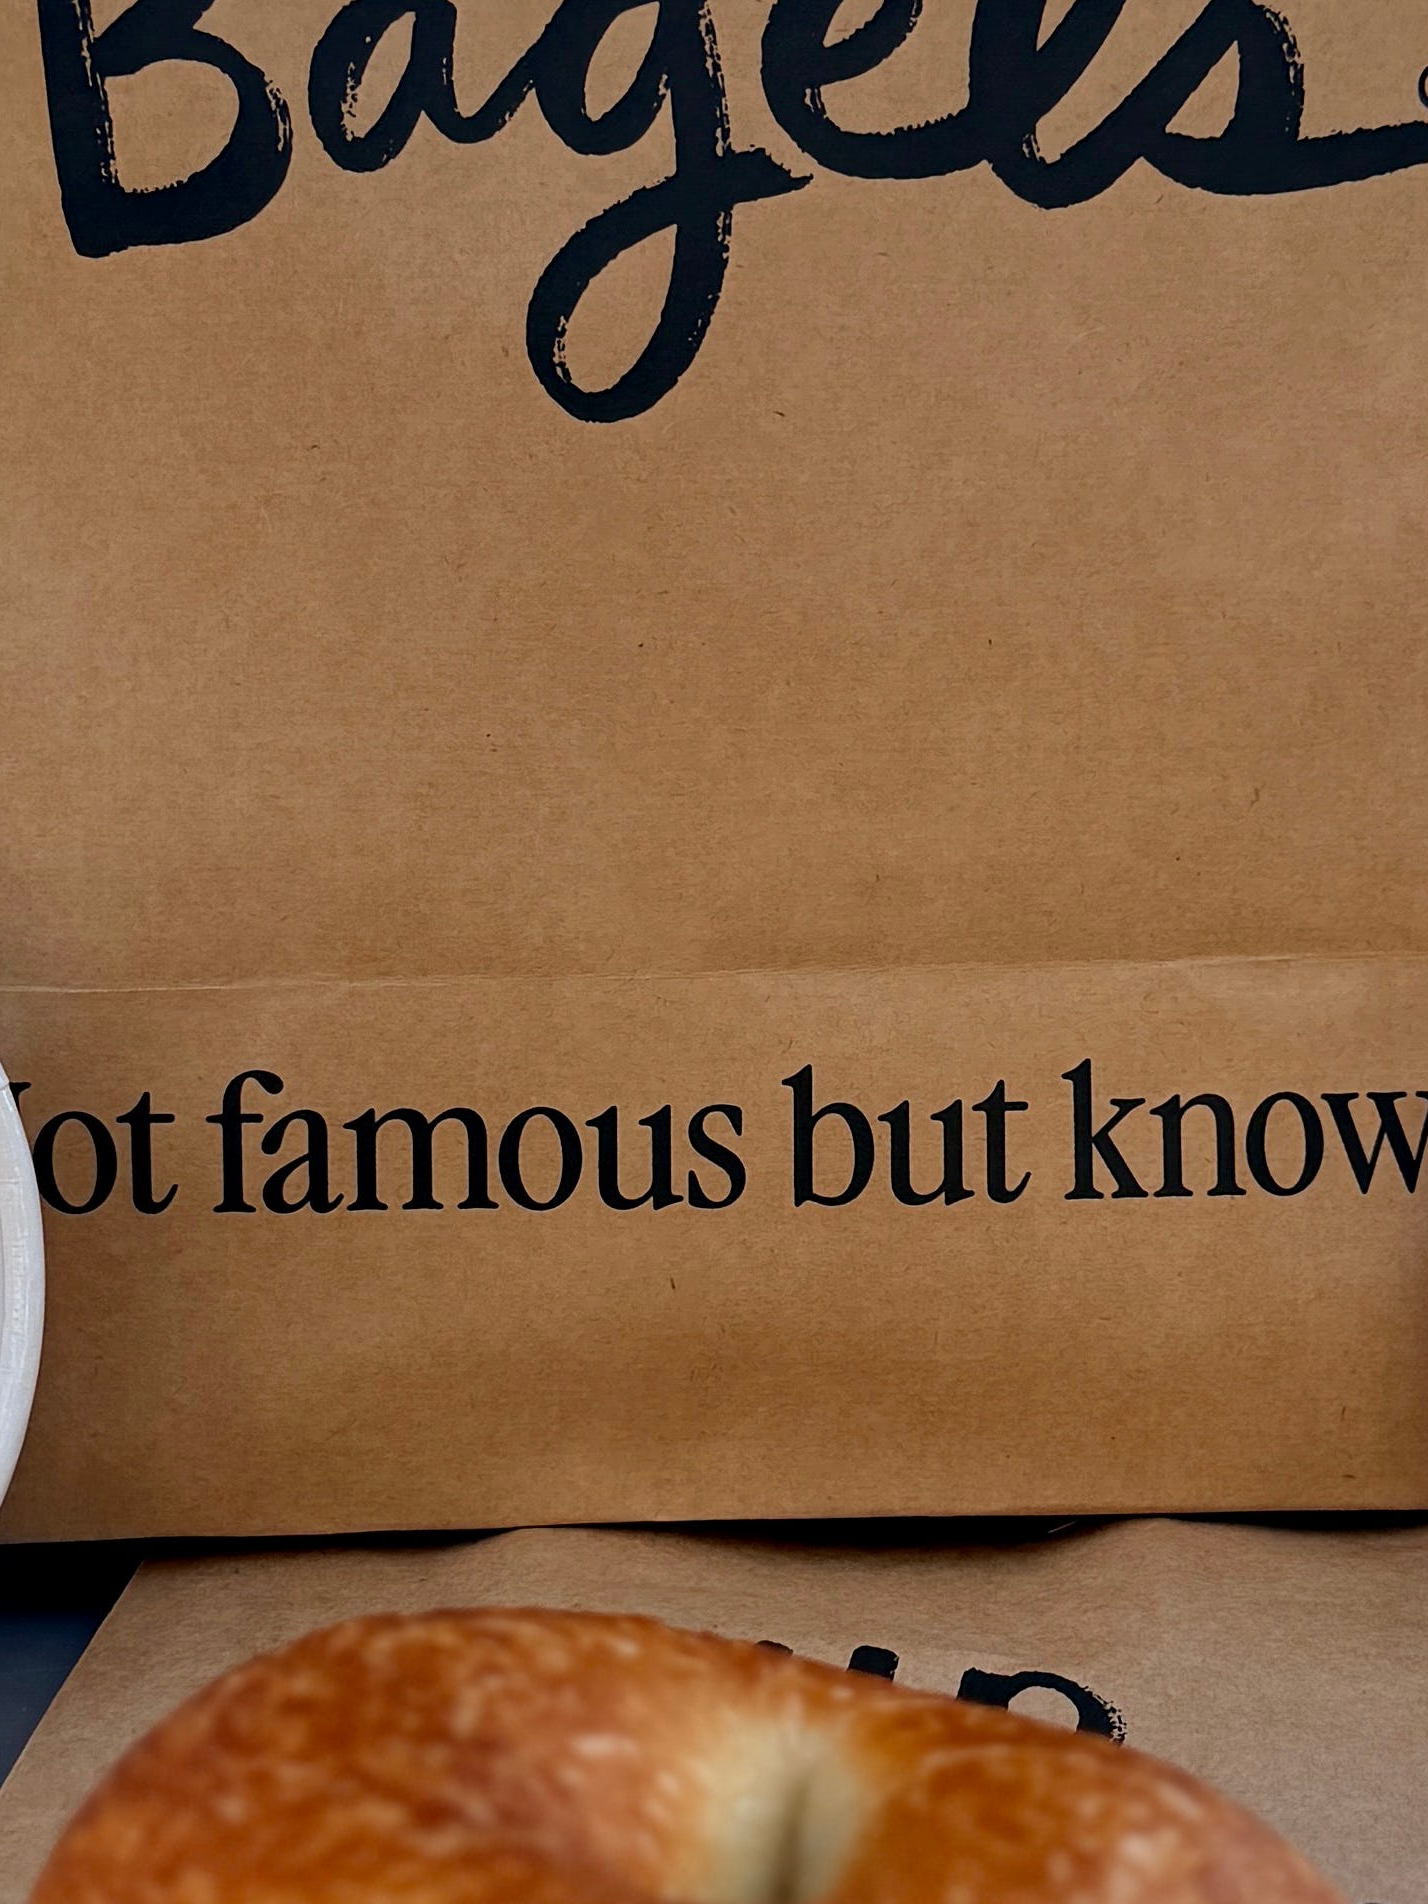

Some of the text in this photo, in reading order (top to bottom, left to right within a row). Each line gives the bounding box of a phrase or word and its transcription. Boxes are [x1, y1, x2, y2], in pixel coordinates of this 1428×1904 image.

[9, 1081, 179, 1215] ot
[205, 1069, 746, 1214] famous
[781, 1064, 1032, 1208] but
